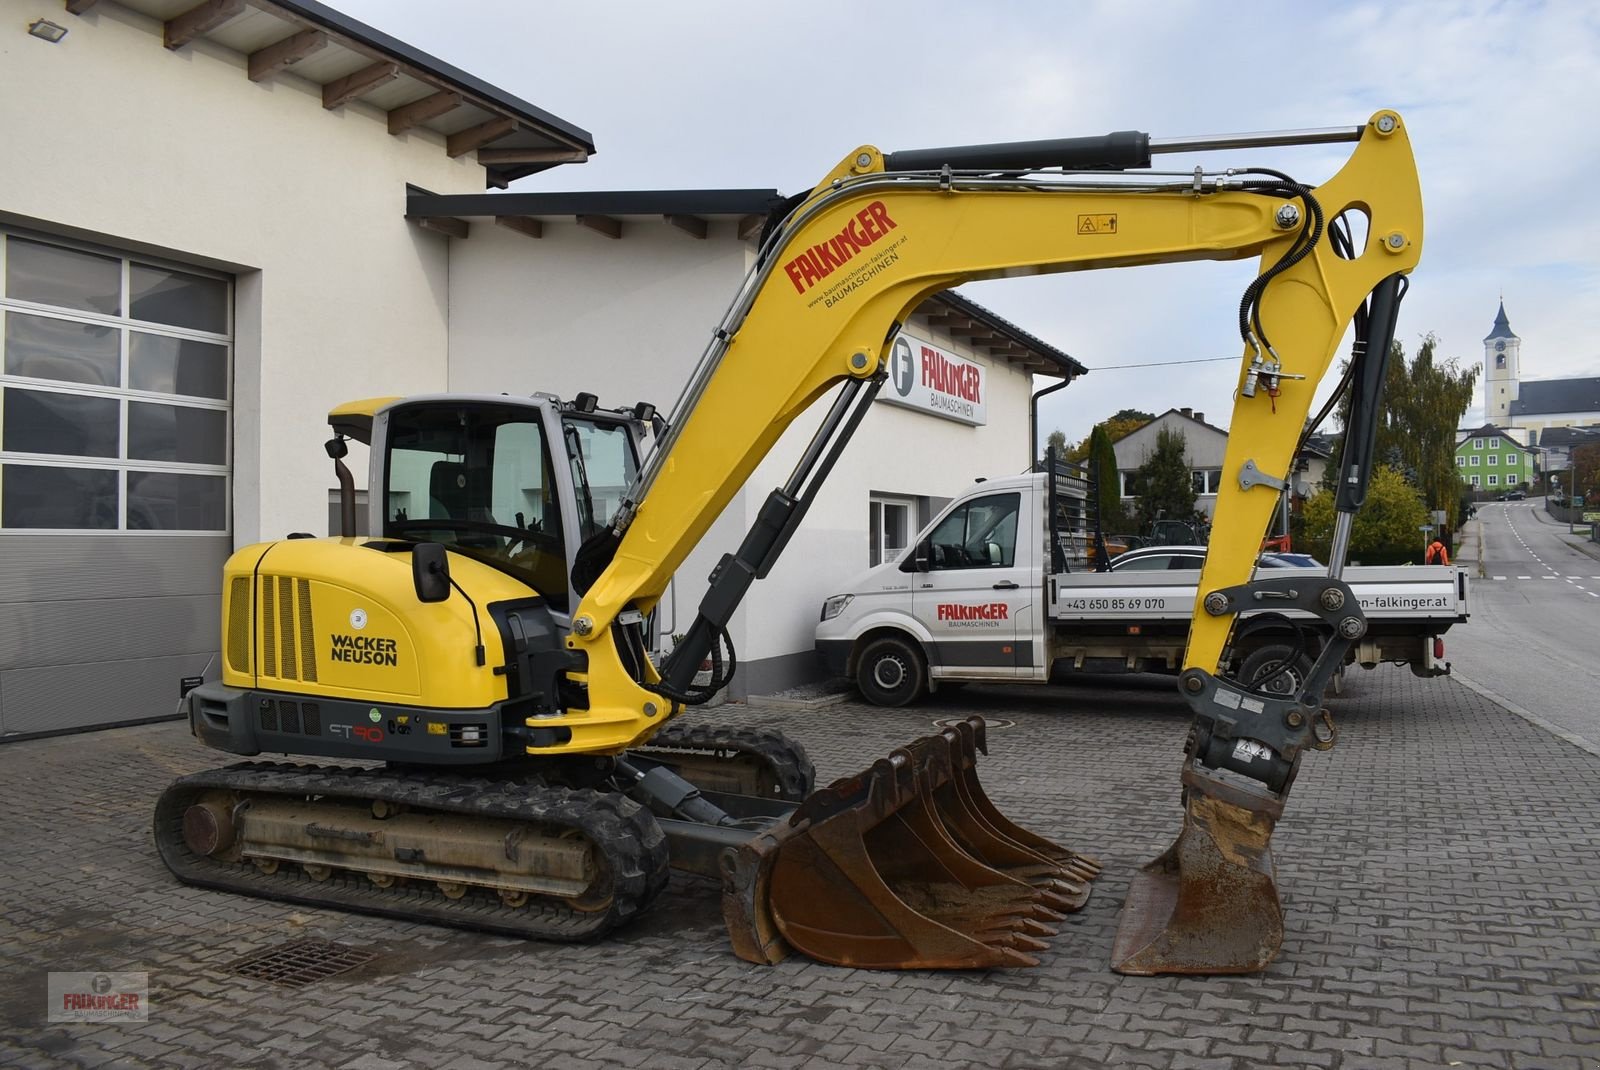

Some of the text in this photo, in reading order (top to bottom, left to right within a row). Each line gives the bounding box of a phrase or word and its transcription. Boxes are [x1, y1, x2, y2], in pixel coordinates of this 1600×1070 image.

[784, 200, 898, 295] FALKINGER
[807, 235, 908, 308] www.baumaschinen-falkinger.at
[824, 252, 899, 308] BAUMASCHINEN
[921, 346, 980, 404] FALKINGER
[930, 393, 974, 417] BAUMASCHINEN
[937, 603, 1009, 620] FALKINGER
[1067, 599, 1165, 609] +43 650 85 69 070
[948, 620, 1000, 628] BAUMASCHINEN
[331, 633, 397, 652] WACKER
[331, 647, 397, 667] NEUSON
